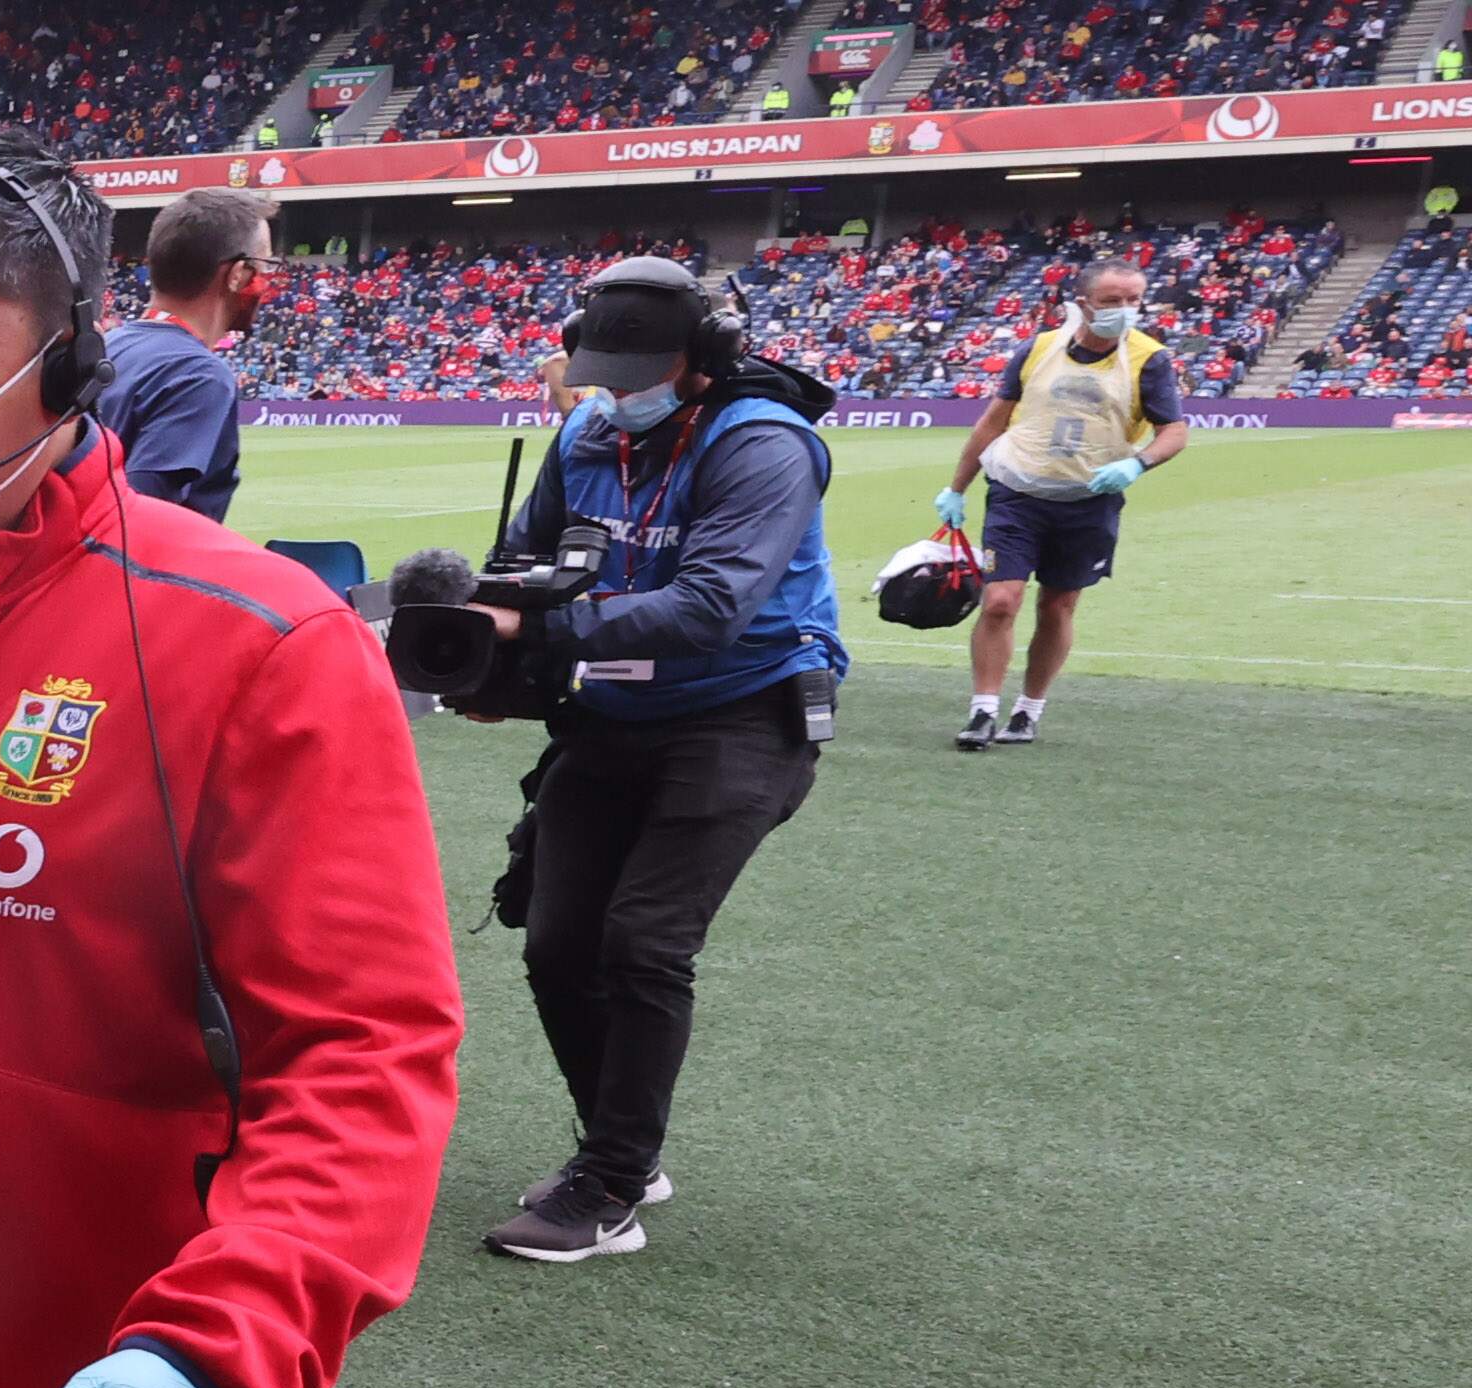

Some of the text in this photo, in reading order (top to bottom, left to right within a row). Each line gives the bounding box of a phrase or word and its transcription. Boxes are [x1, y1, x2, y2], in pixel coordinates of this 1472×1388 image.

[1372, 97, 1472, 121] LIONS
[608, 140, 688, 161] LIONS
[710, 134, 802, 156] JAPAN
[107, 169, 178, 188] JAPAN
[269, 412, 402, 426] ROYAL LONDON
[847, 412, 932, 427] FIELD
